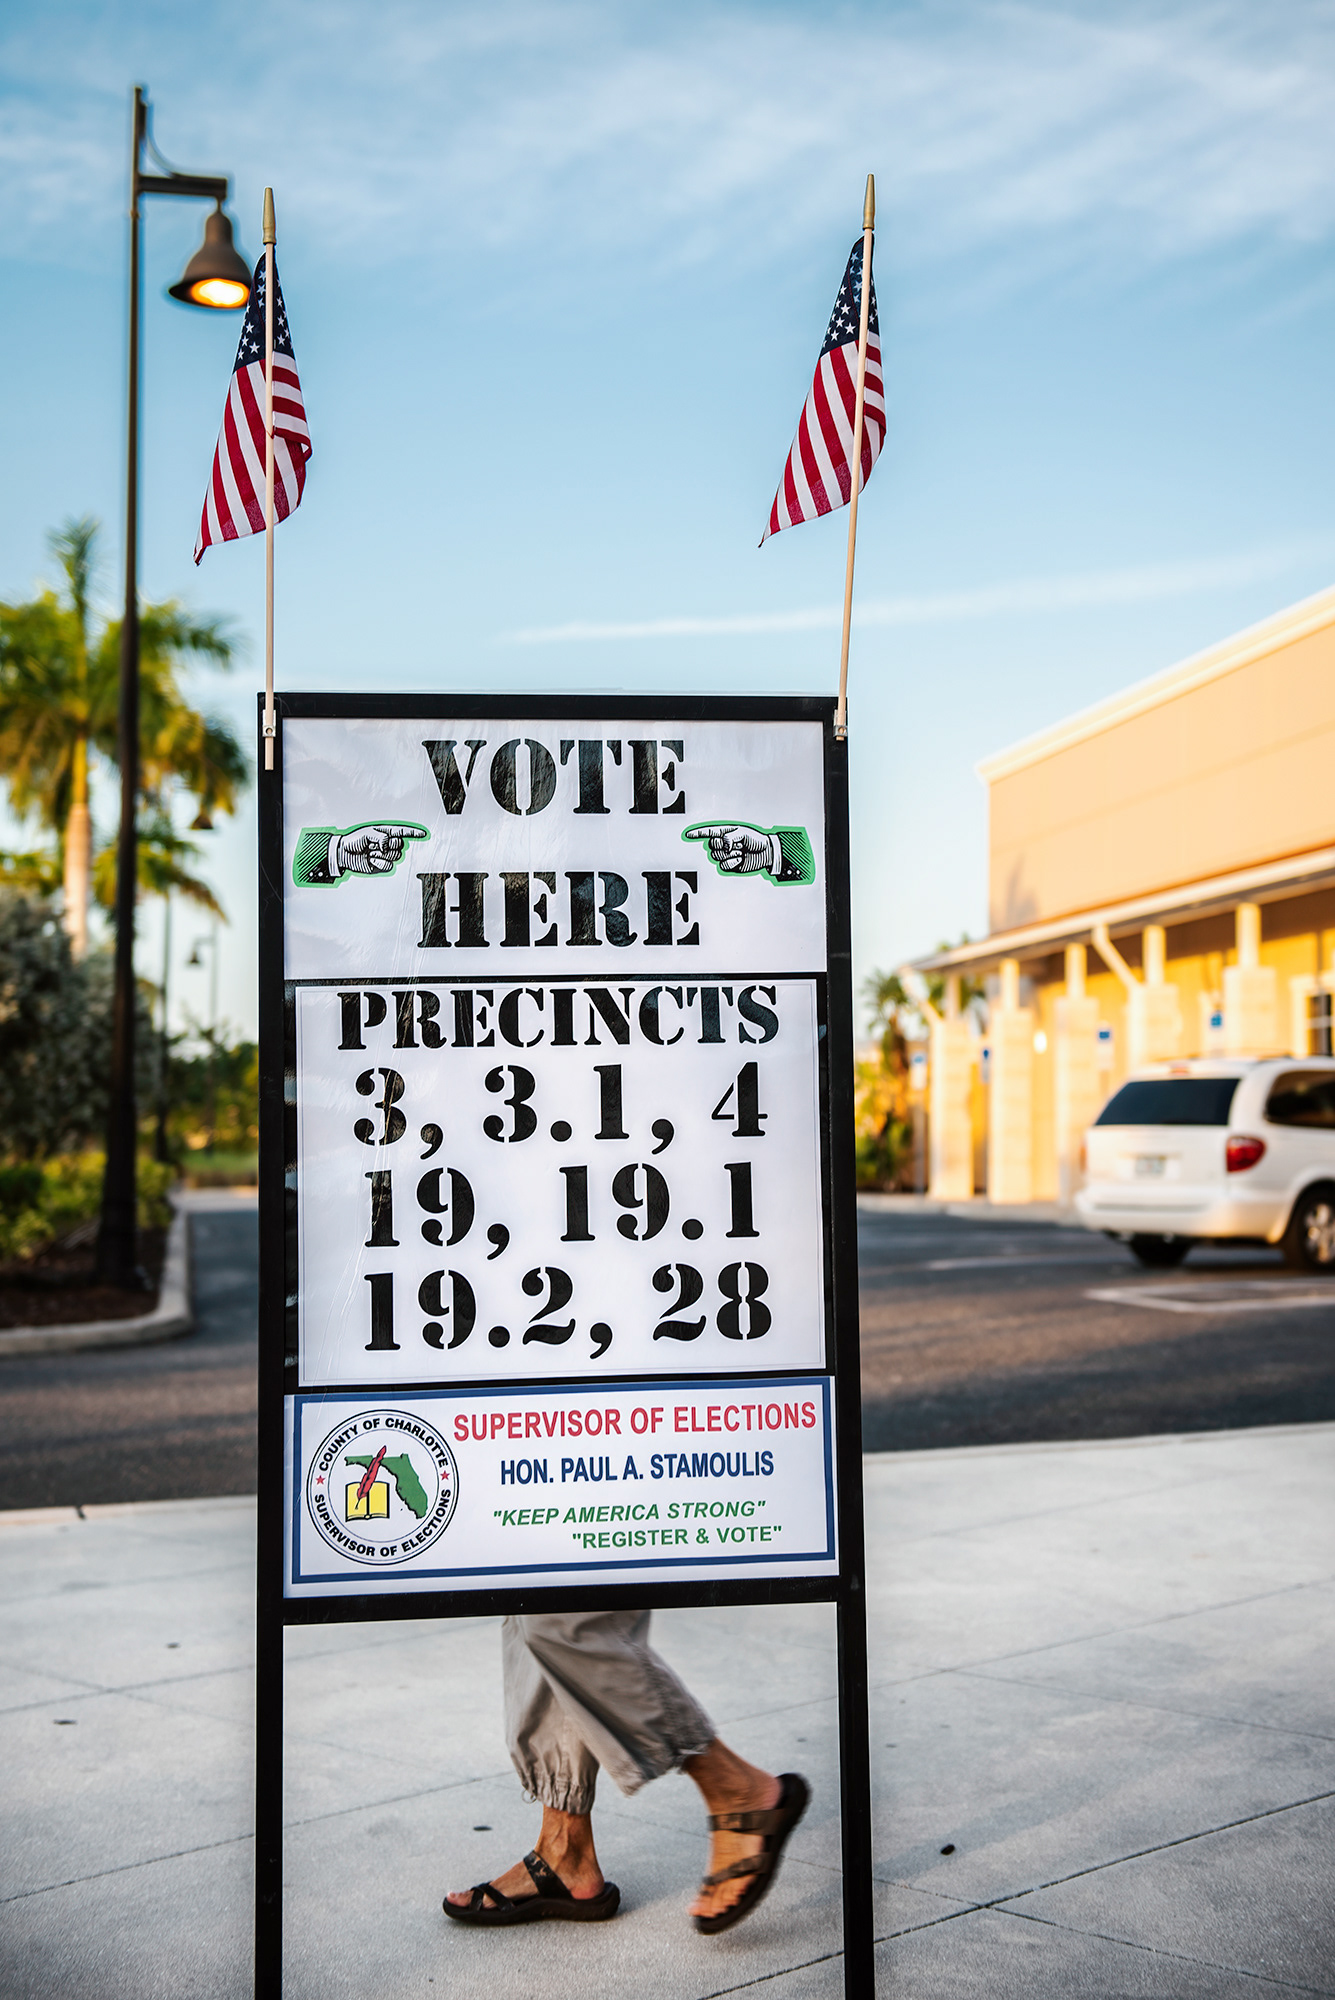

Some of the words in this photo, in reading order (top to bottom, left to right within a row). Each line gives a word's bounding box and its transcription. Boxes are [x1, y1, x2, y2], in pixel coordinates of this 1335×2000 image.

[421, 739, 686, 815] VOTE
[416, 871, 700, 948] HERE
[337, 984, 779, 1050] PRECINCTS
[353, 1067, 443, 1160] 3,
[483, 1062, 675, 1154] 3.1,
[711, 1061, 768, 1137] 4
[364, 1167, 510, 1260] 19,
[559, 1161, 759, 1242] 19.1
[364, 1266, 613, 1360] 19.2,
[651, 1261, 772, 1342] 28
[319, 1424, 358, 1471] COUNTY
[363, 1418, 380, 1430] OF
[385, 1418, 449, 1468] CHARLOTTE
[454, 1409, 621, 1442] SUPERVISOR
[630, 1405, 663, 1434] OF
[673, 1401, 817, 1433] ELECTIONS
[500, 1457, 554, 1485] HON.
[560, 1455, 617, 1483] PAUL
[622, 1454, 643, 1481] A.
[649, 1450, 774, 1479] STAMOULIS
[315, 1494, 375, 1557] SUPERVISOR
[380, 1547, 397, 1557] OF
[402, 1489, 451, 1552] ELECTIONS
[493, 1508, 560, 1527] "KEEP
[562, 1504, 661, 1524] AMERICA
[667, 1500, 767, 1520] STRONG"
[572, 1530, 688, 1550] "REGISTER
[696, 1528, 710, 1545] &
[716, 1525, 782, 1544] VOTE"
